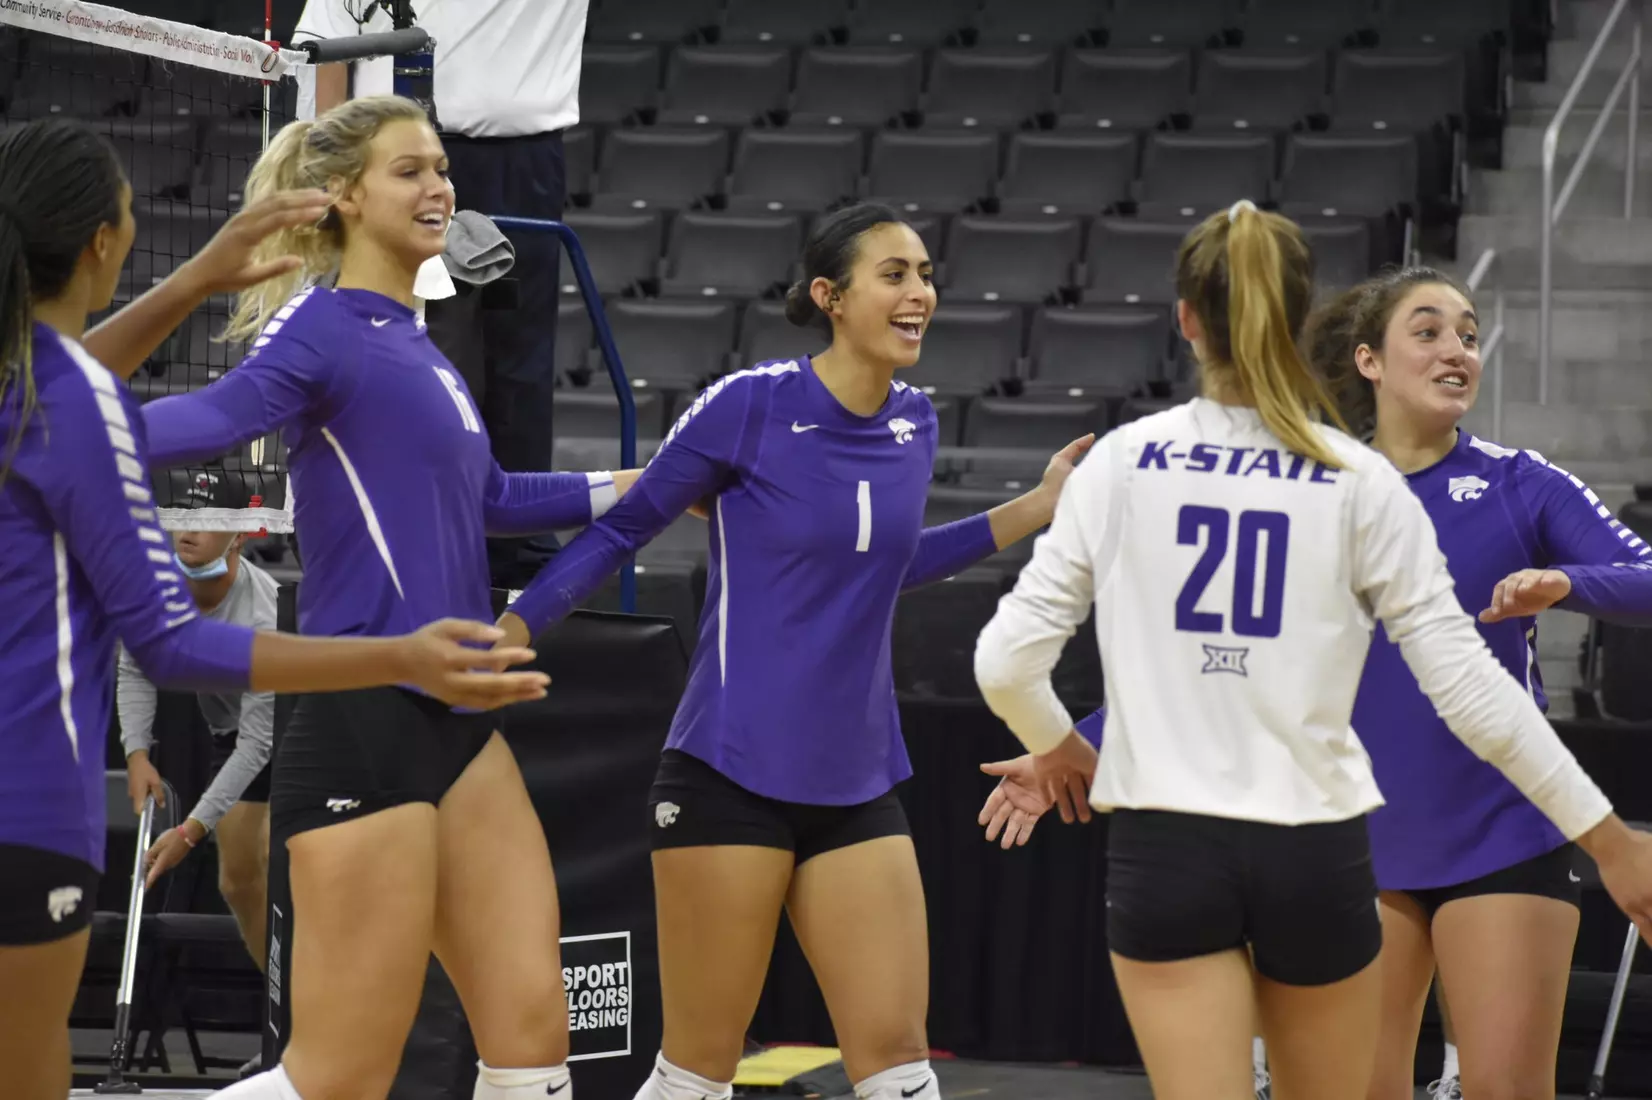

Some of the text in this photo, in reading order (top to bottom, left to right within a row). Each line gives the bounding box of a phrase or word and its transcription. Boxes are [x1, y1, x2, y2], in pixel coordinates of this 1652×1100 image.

[1137, 441, 1341, 484] K-STATE
[856, 480, 872, 552] 1
[1175, 505, 1290, 638] 20
[561, 961, 628, 991] SPORT
[565, 986, 629, 1011] LOORS
[568, 1007, 628, 1031] EASING
